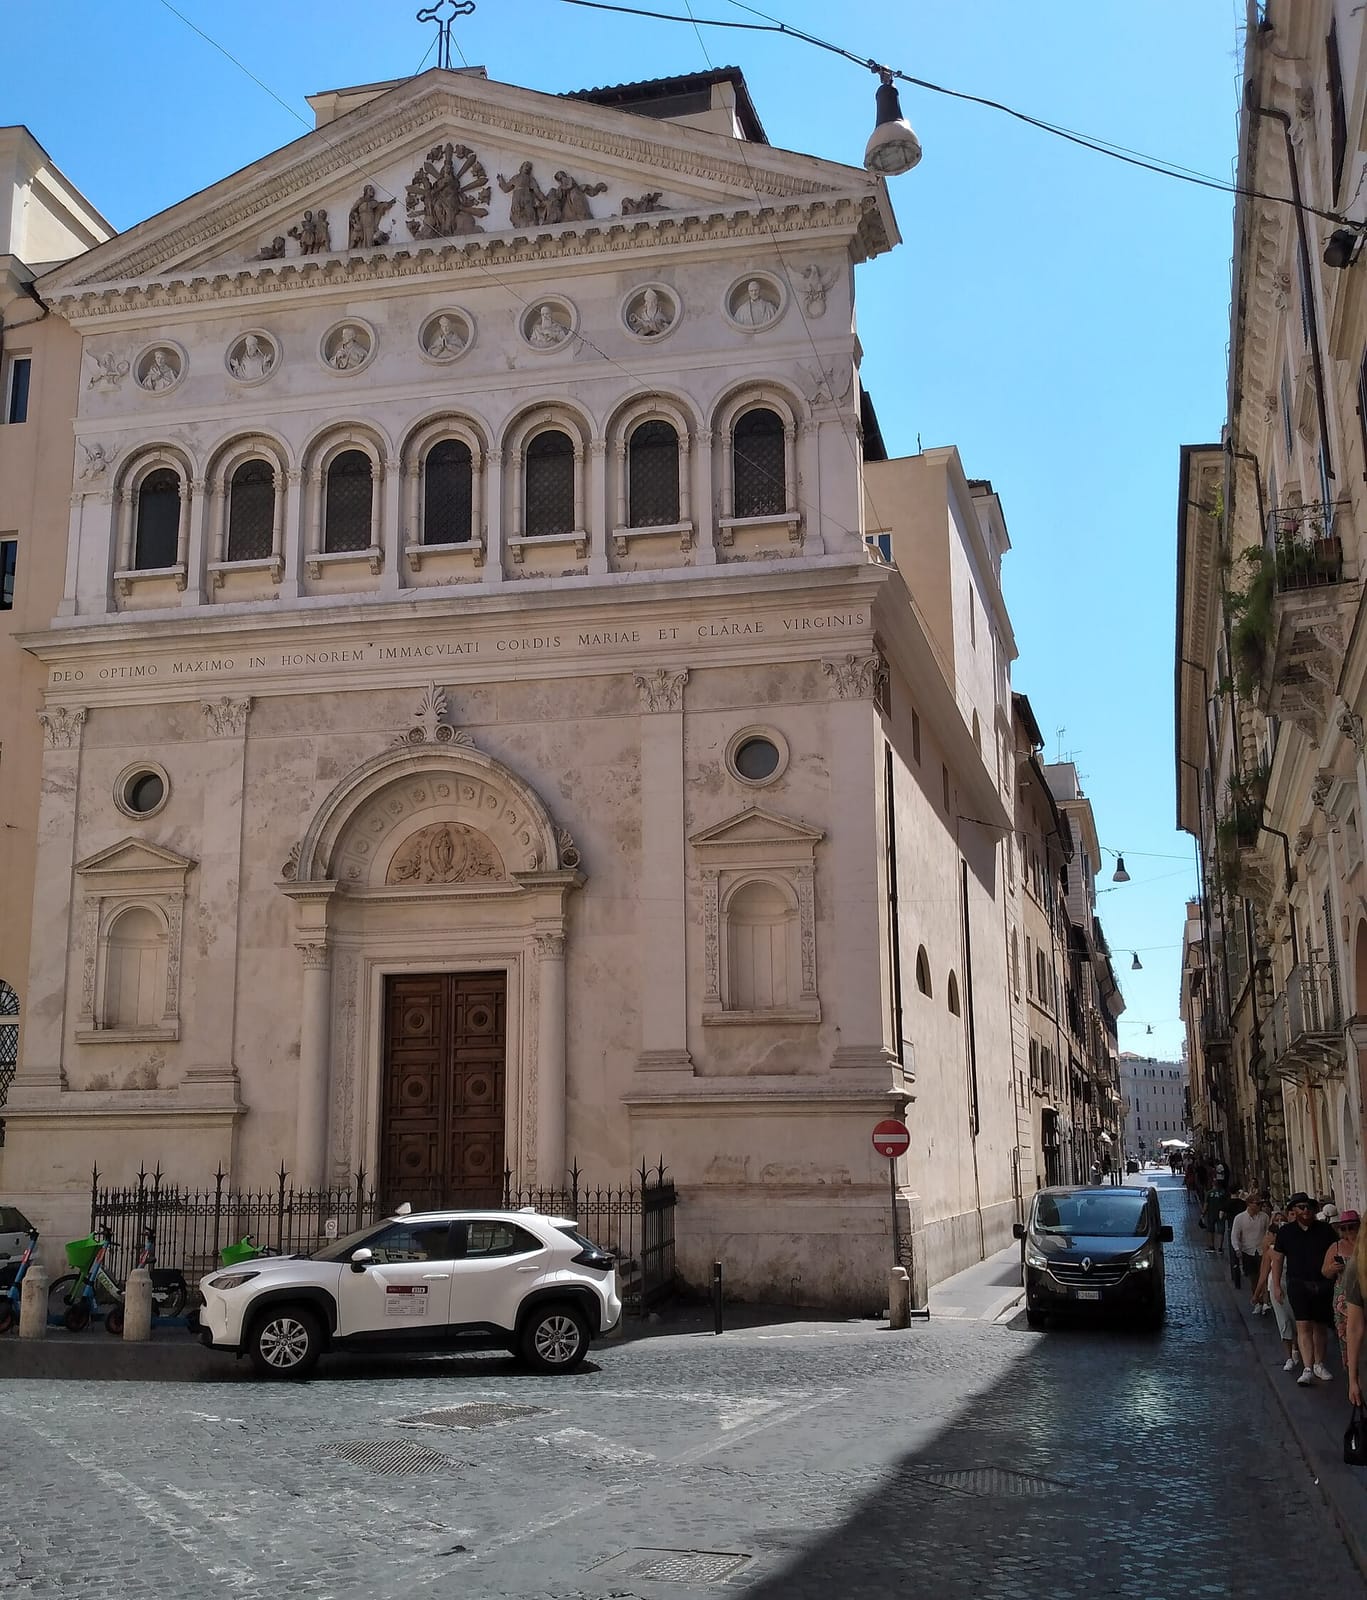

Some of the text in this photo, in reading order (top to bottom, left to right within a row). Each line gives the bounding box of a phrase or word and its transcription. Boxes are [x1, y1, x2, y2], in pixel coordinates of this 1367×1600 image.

[52, 613, 865, 682] DEO OPTIMO MAXIMO IN HONOREM IMMACVLATI CORDIS MARIAE ET CLARAE VIRGINIS
